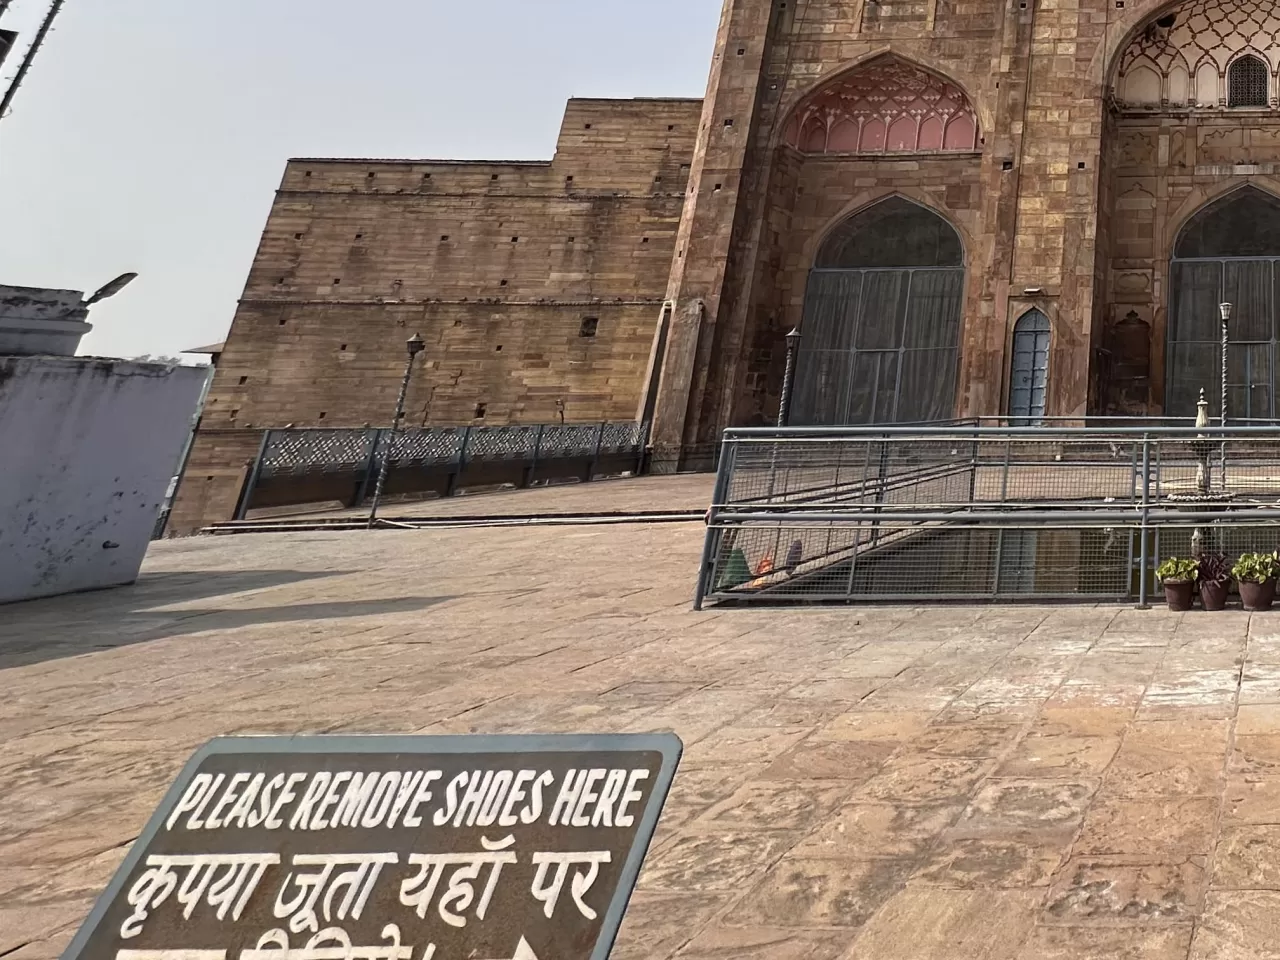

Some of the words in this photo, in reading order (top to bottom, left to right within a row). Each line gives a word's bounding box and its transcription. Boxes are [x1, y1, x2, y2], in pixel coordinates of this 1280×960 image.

[166, 772, 308, 831] PLEASE
[289, 770, 443, 830] REMOVE
[432, 769, 555, 827] SHOES
[548, 768, 650, 827] HERE
[120, 852, 281, 939] कृपया
[273, 852, 400, 934] जूता
[531, 850, 612, 920] पर
